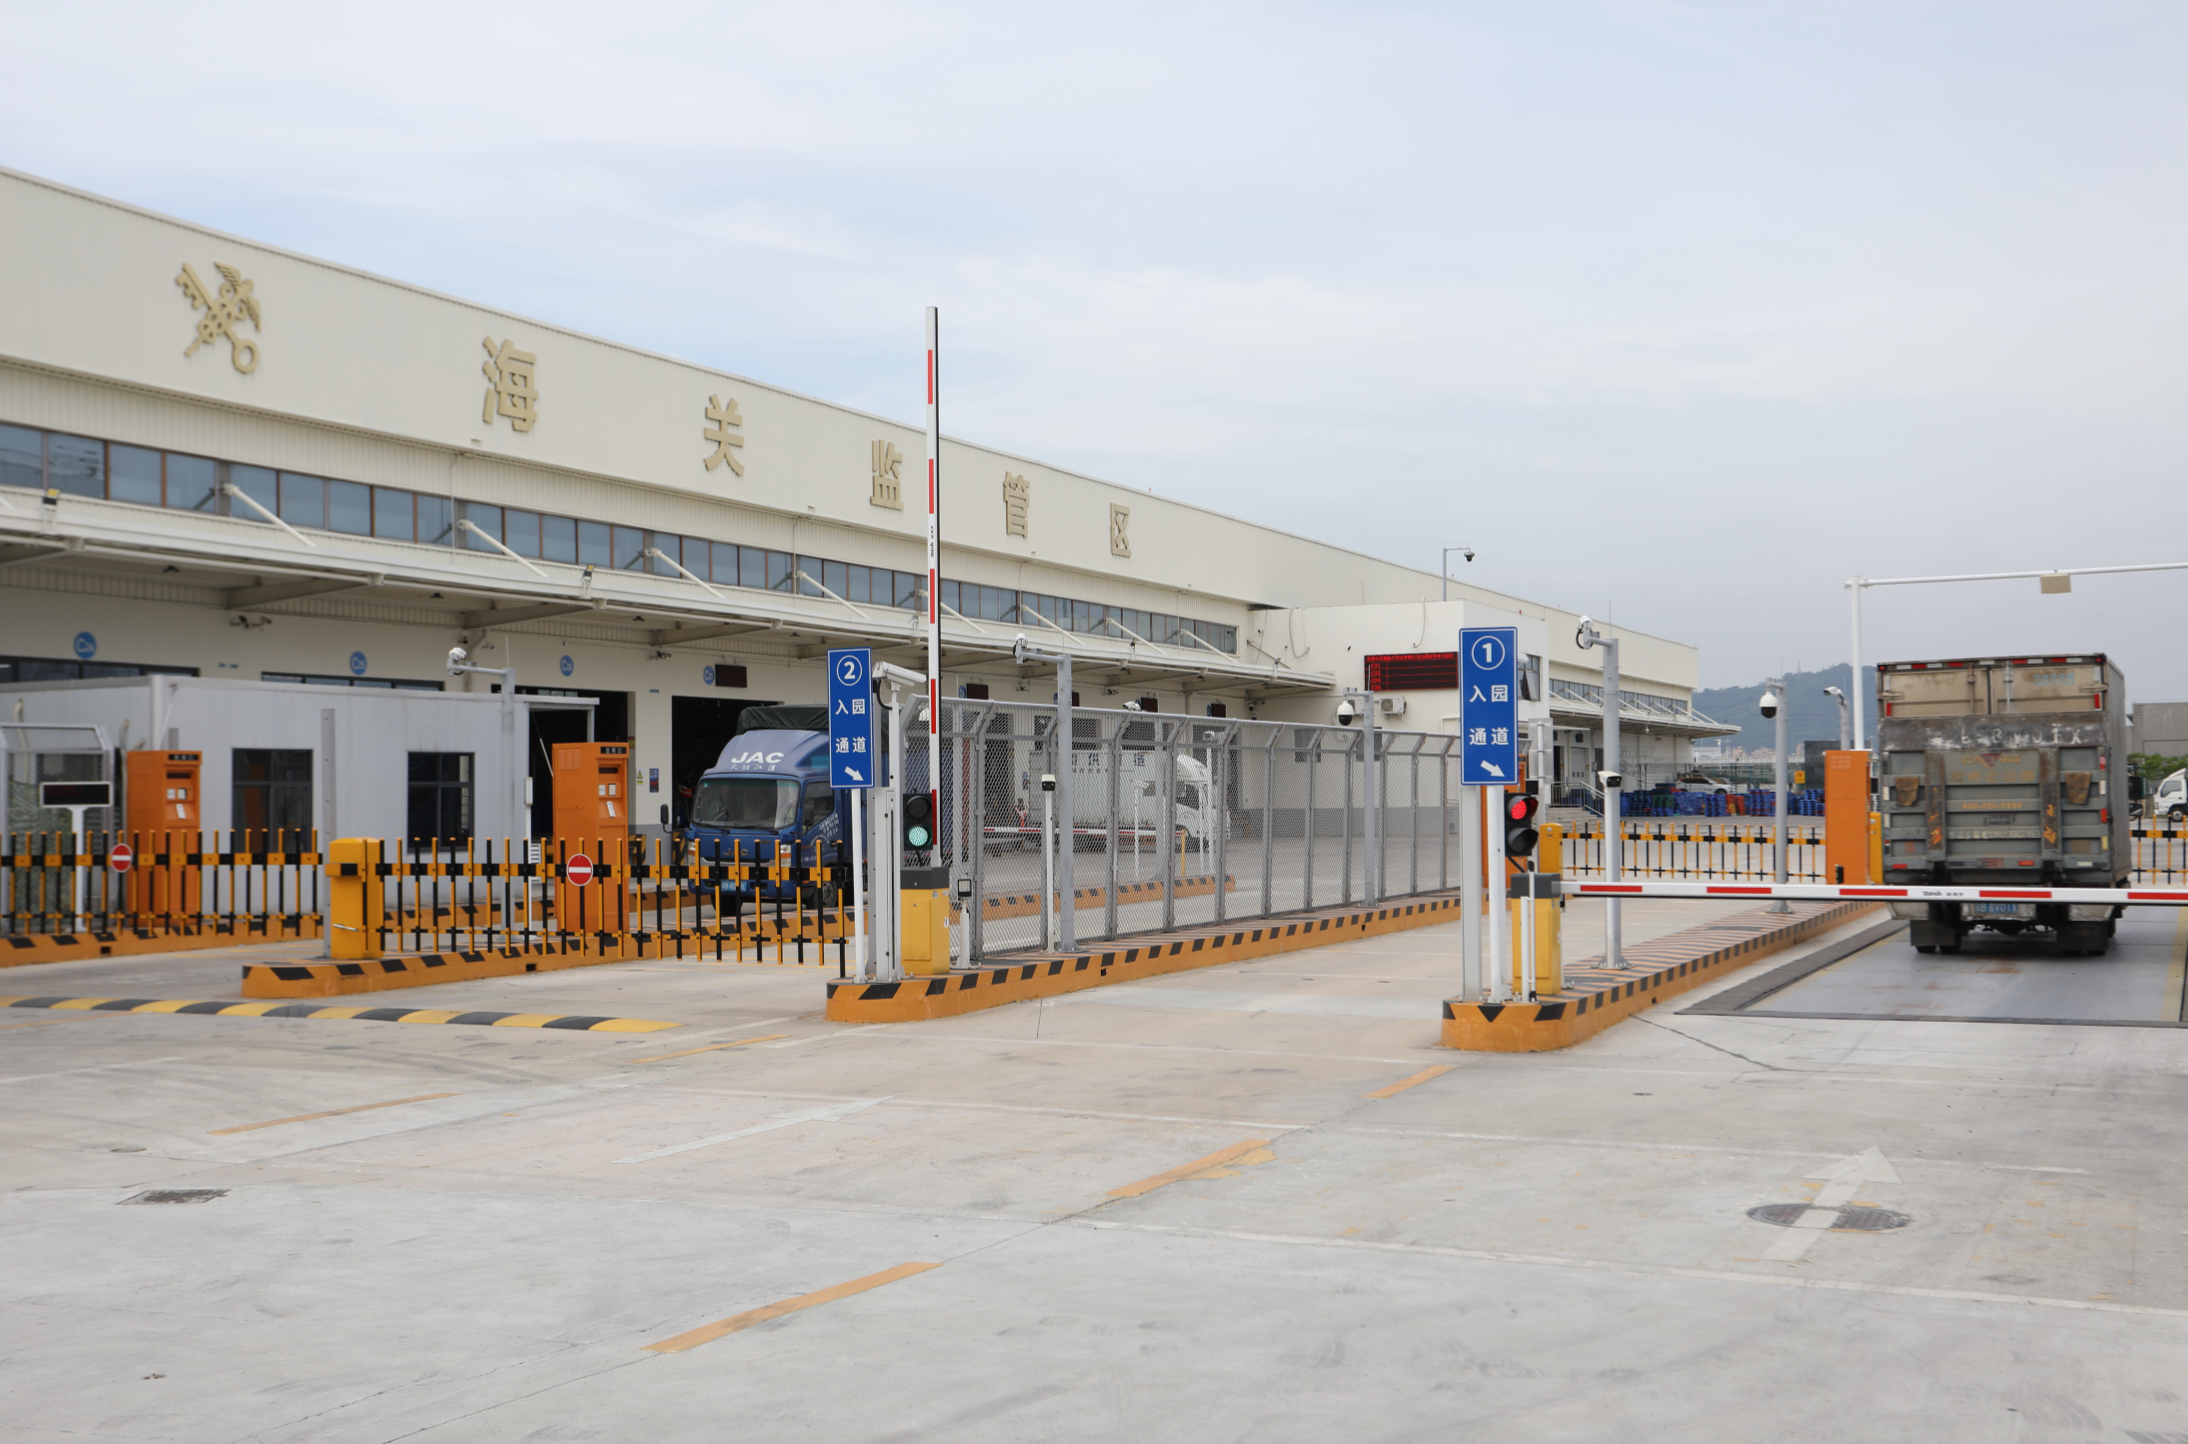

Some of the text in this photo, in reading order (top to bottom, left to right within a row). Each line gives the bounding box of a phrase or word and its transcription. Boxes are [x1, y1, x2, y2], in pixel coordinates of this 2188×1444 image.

[482, 335, 1132, 559] 海关监管区
[1469, 684, 1509, 704] 入园
[835, 698, 866, 715] 入园
[835, 736, 867, 754] 通道
[1468, 726, 1510, 746] 通道
[731, 751, 785, 764] JAC
[724, 848, 749, 857] JC
